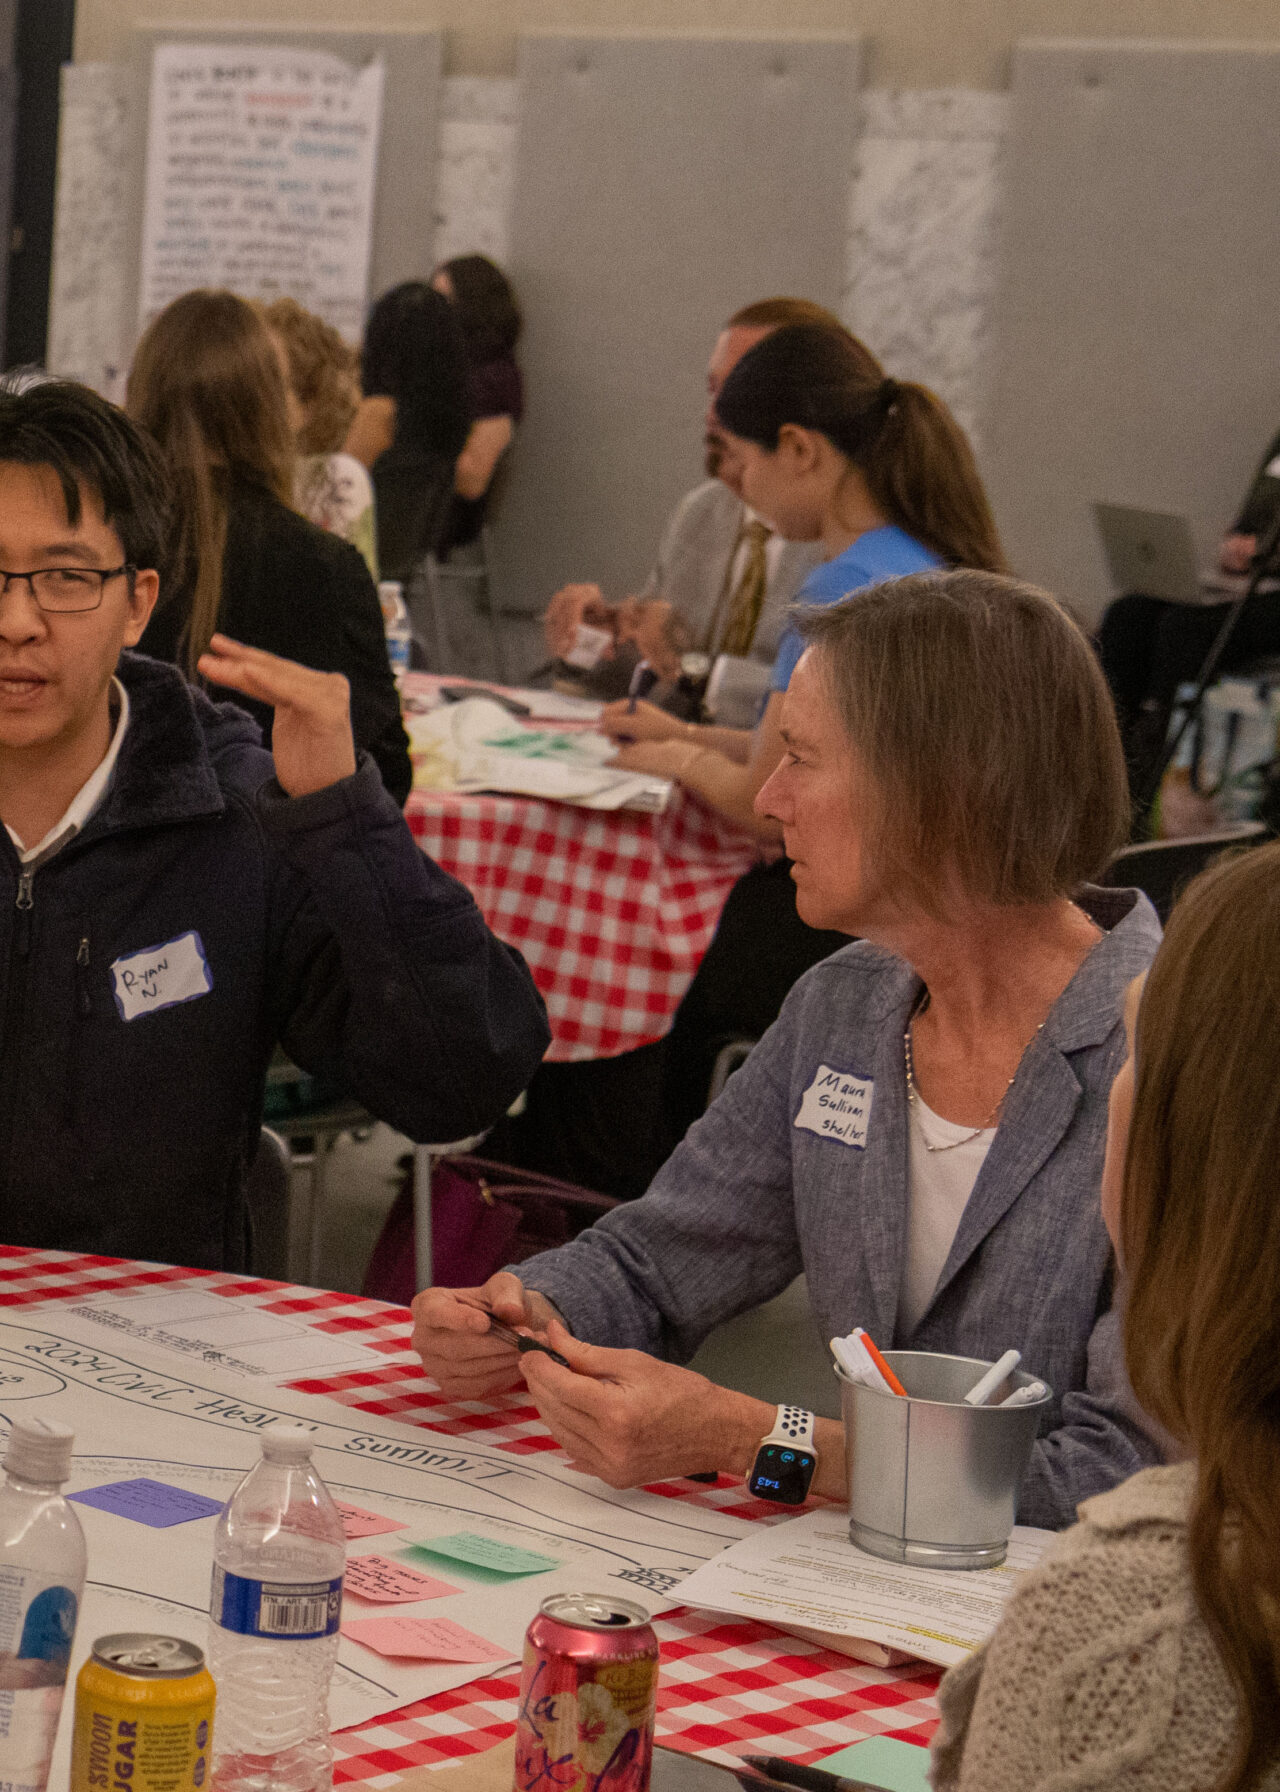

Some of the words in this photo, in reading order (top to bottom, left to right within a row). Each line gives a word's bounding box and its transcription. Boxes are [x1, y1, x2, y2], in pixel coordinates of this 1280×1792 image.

[818, 1094, 864, 1118] Sullivan
[1, 1374, 25, 1383] is
[24, 1341, 117, 1373] 2024
[194, 1399, 318, 1432] Heal
[757, 1476, 780, 1489] 1:43
[87, 1712, 113, 1789] SWOON
[113, 1719, 138, 1792] UGAR
